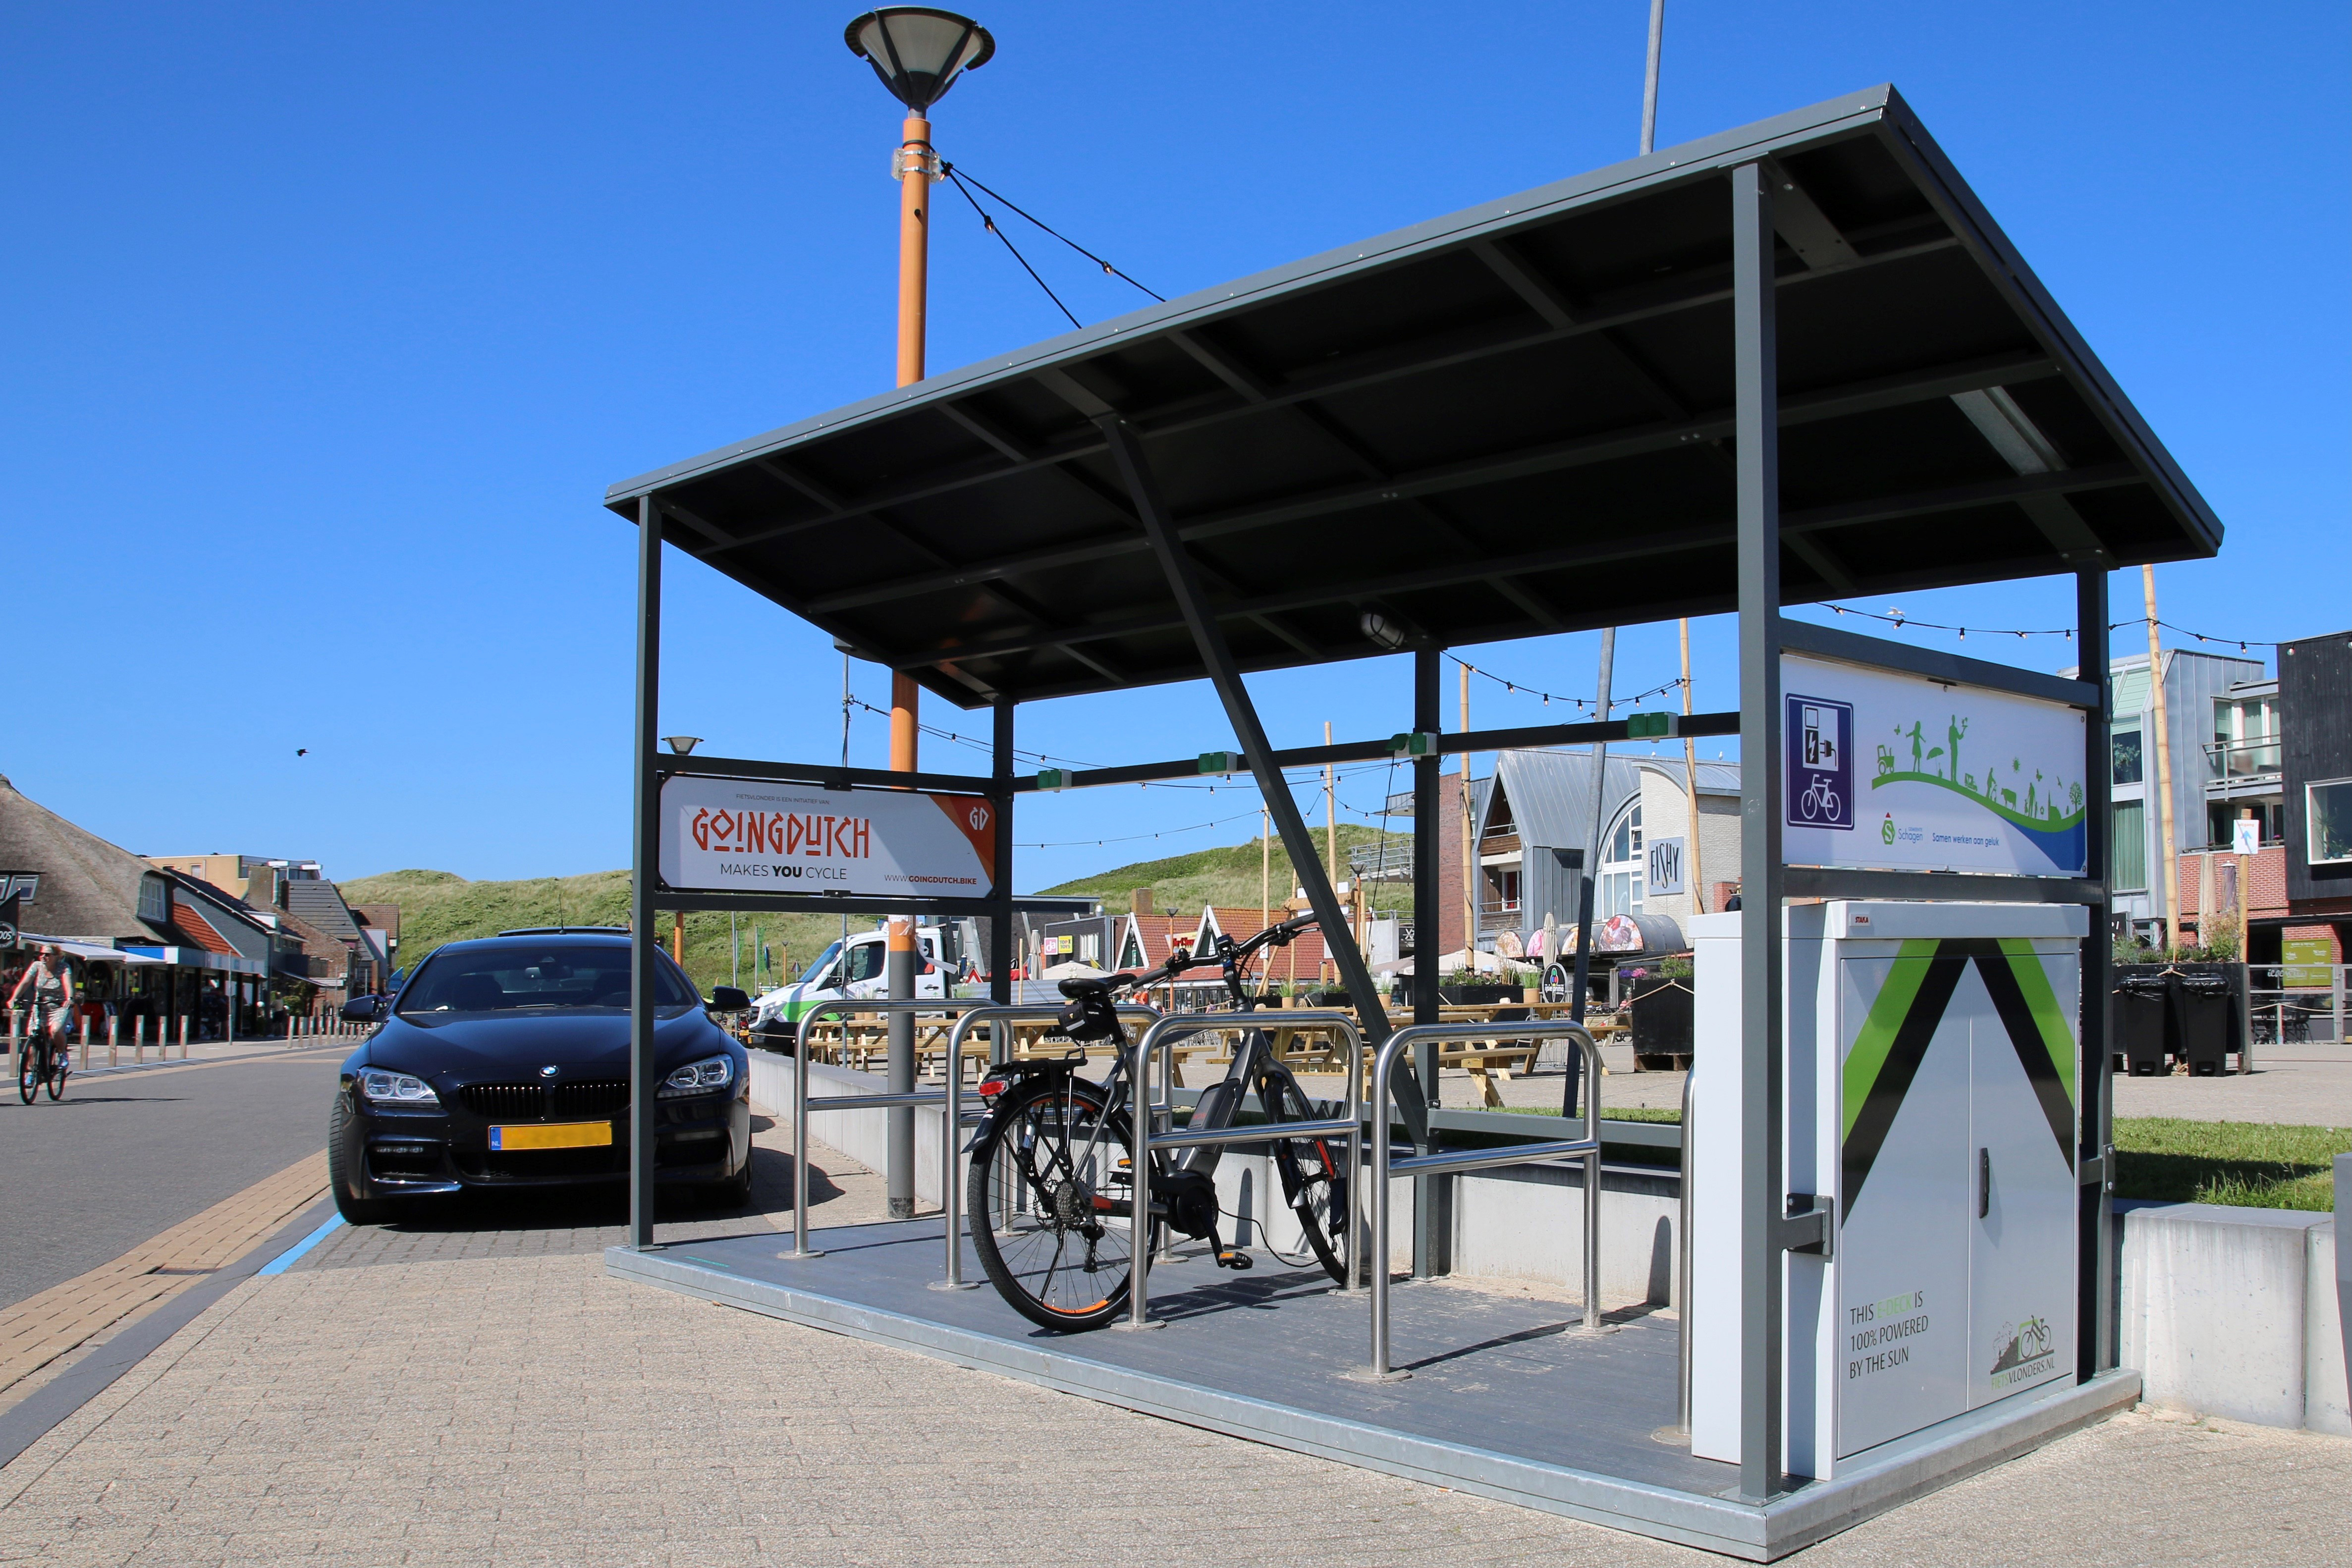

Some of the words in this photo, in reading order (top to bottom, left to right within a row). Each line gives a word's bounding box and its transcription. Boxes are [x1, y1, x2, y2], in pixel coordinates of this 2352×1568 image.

[692, 807, 870, 858] GOINGDUTCH
[969, 807, 989, 830] GD
[1898, 828, 1923, 844] Schagen
[1932, 832, 1952, 843] Samen
[1953, 835, 1972, 845] werken
[1985, 837, 2000, 847] geluk
[721, 863, 769, 876] MAKES
[772, 865, 802, 878] YOU
[806, 867, 847, 879] CYCLE
[884, 874, 977, 885] WWW.GOINGDUTCH.BIKE
[1650, 843, 1679, 889] FISHY
[1850, 1303, 1874, 1325] THIS
[1877, 1294, 1913, 1319] E-DECK
[1915, 1291, 1923, 1308] IS
[1851, 1329, 1877, 1352] 100%
[1880, 1315, 1928, 1344] POWERED
[1850, 1359, 1863, 1379] BY
[1865, 1353, 1885, 1374] THE
[1888, 1346, 1909, 1368] SUN
[1991, 1357, 2055, 1390] FIETSVLONDERS.NL
